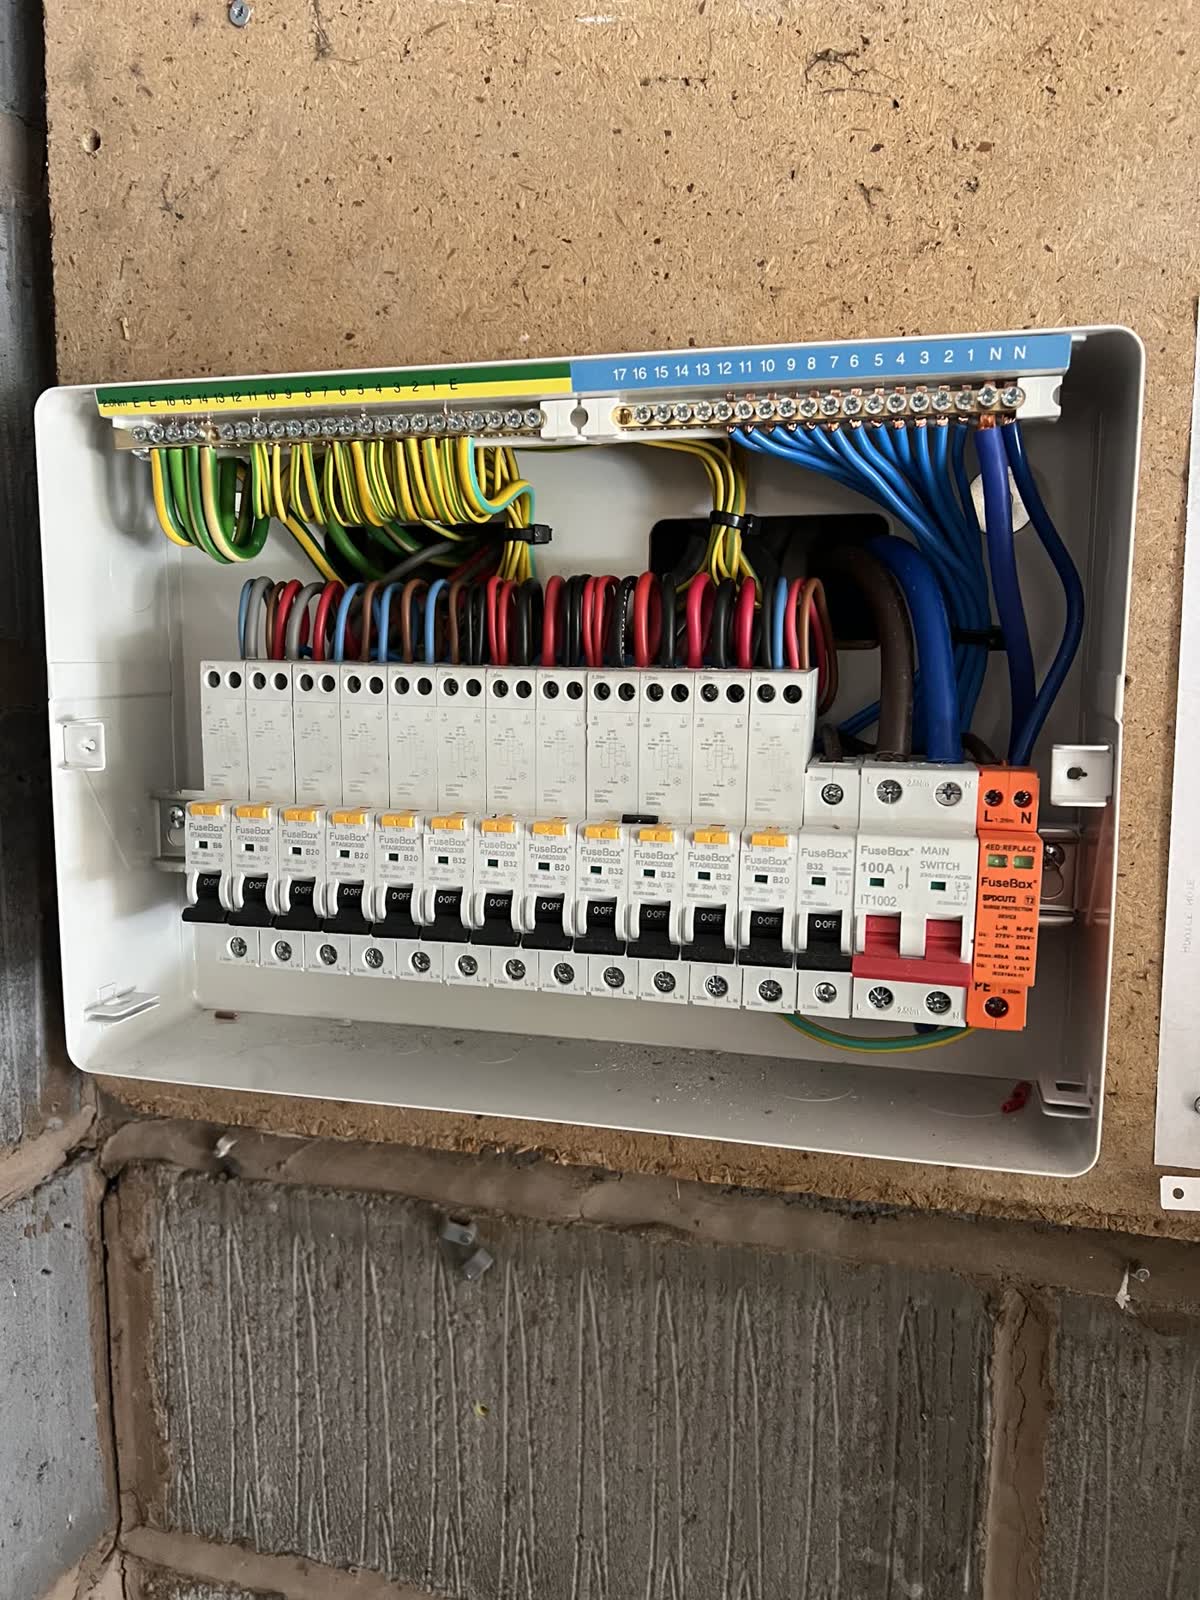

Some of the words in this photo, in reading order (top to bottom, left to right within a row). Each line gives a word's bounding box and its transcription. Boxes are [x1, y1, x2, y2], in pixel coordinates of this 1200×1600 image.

[613, 368, 626, 381] 17
[632, 367, 646, 380] 16
[654, 366, 668, 378] 15
[675, 364, 688, 377] 14
[696, 363, 710, 376] 13
[717, 362, 732, 374] 12
[739, 360, 752, 374] 11
[760, 359, 776, 372] 10
[787, 358, 796, 370] 9
[807, 357, 816, 370] 8
[829, 356, 840, 368] 7
[850, 354, 859, 367] 6
[874, 353, 884, 366] 5
[896, 352, 905, 365] 4
[920, 351, 929, 364] 3
[944, 350, 954, 363] 2
[967, 349, 973, 361] 1
[990, 347, 1002, 360] N
[1014, 346, 1026, 360] N
[133, 398, 140, 408] E
[149, 397, 157, 407] E
[164, 396, 176, 406] 16
[181, 396, 192, 406] 15
[198, 394, 209, 404] 14
[213, 393, 225, 404] 13
[230, 392, 242, 402] 12
[248, 391, 258, 401] 11
[265, 390, 276, 400] 10
[285, 388, 292, 400] 9
[304, 387, 312, 398] 8
[322, 386, 328, 397] 7
[340, 385, 346, 396] 6
[358, 384, 365, 395] 5
[376, 383, 382, 394] 4
[394, 382, 401, 393] 3
[412, 380, 419, 392] 2
[450, 378, 458, 390] E
[984, 810, 993, 822] L
[1021, 812, 1032, 824] N
[189, 823, 224, 832] FuseBox
[236, 826, 270, 834] FuseBox
[282, 830, 318, 839] FuseBox
[330, 832, 366, 842] FuseBox
[379, 836, 416, 844] FuseBox
[428, 837, 466, 846] FuseBox
[479, 840, 517, 850] FuseBox
[306, 848, 320, 856] B20
[528, 844, 568, 854] FuseBox
[580, 847, 621, 857] FuseBox
[802, 848, 848, 859] FuseBox
[861, 846, 910, 856] FuseBox
[921, 846, 950, 856] MAIN
[354, 852, 368, 860] B20
[404, 854, 418, 862] B20
[634, 850, 675, 860] FuseBox
[688, 852, 731, 862] FuseBox
[504, 860, 518, 868] B32
[744, 855, 788, 866] FuseBox
[554, 864, 570, 872] B20
[806, 862, 823, 871] B32
[861, 862, 895, 874] 100A
[920, 861, 960, 871] SWITCH
[772, 876, 790, 884] B20
[982, 878, 1033, 889] FuseBox
[860, 895, 897, 907] IT1002
[982, 894, 1016, 903] SPDCUT2
